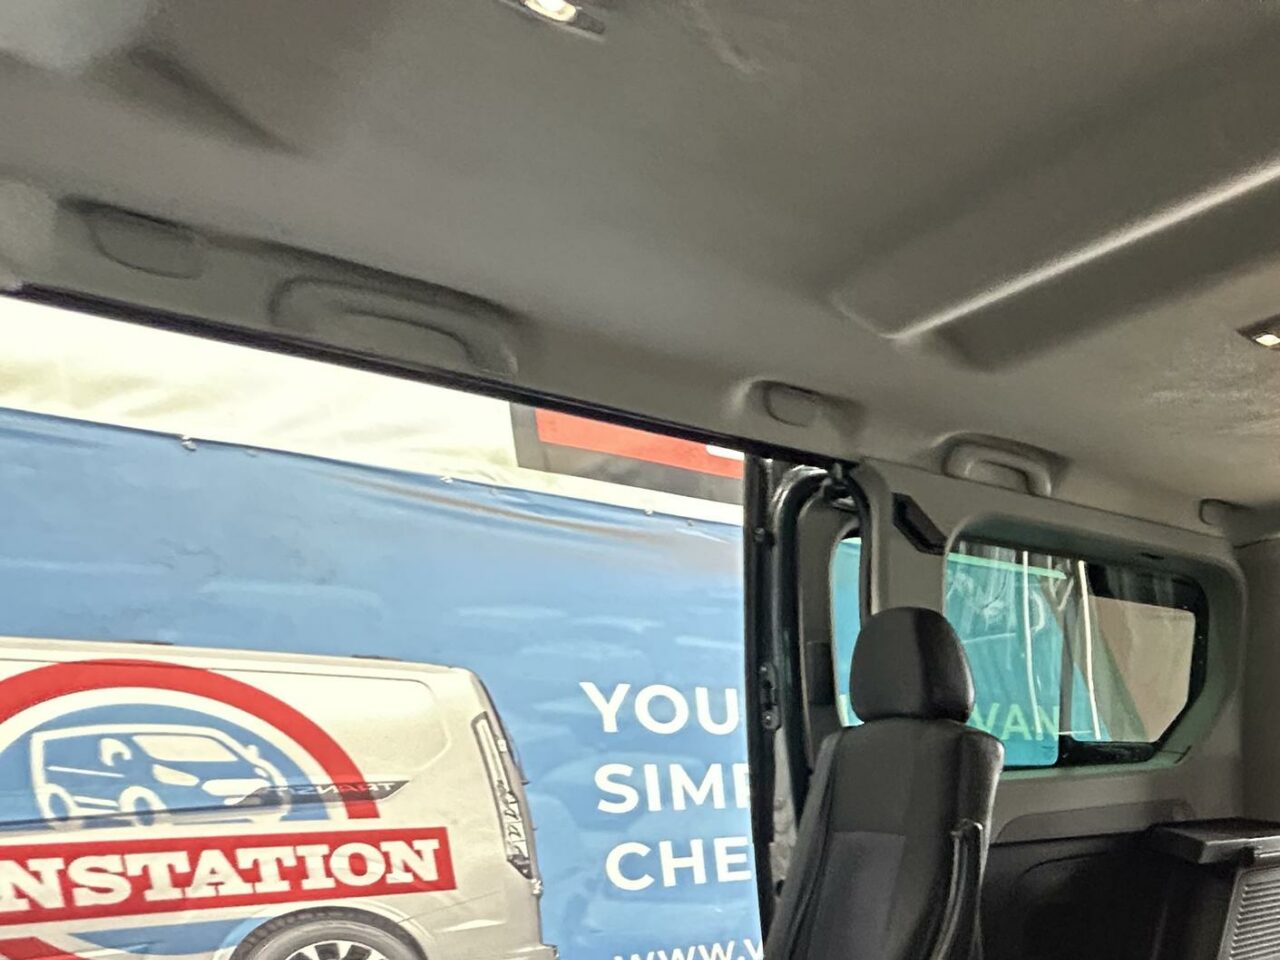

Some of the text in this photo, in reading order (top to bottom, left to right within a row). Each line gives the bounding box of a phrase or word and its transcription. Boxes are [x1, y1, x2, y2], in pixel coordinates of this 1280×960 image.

[579, 681, 1058, 741] YOU VAN
[0, 838, 440, 913] NSTATION
[605, 836, 752, 891] CHE
